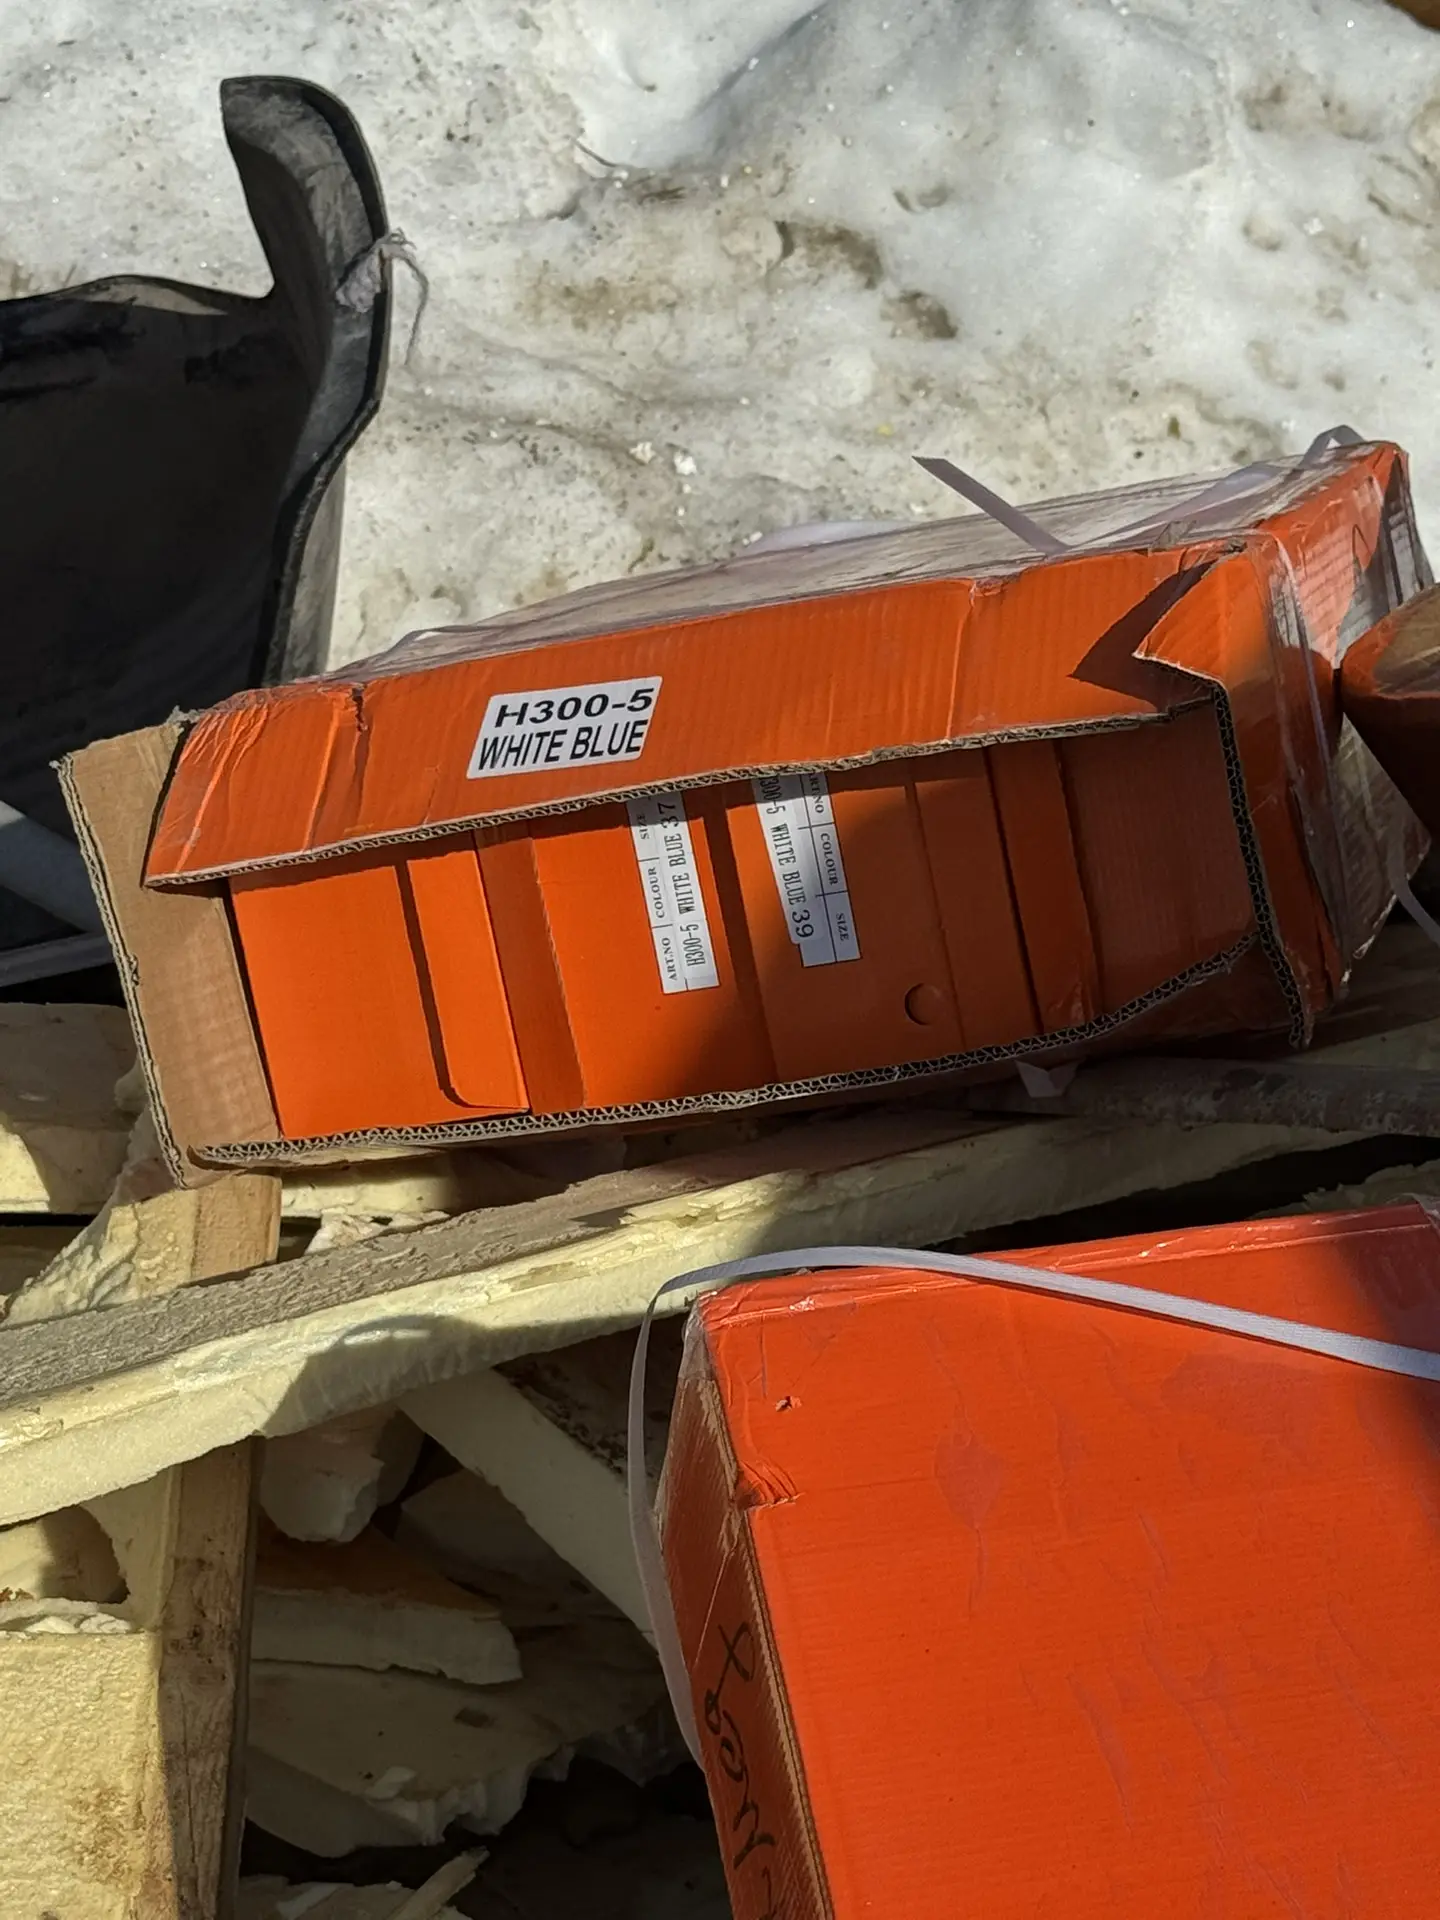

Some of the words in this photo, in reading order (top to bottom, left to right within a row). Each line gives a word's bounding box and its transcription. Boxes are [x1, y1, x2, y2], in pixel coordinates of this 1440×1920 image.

[494, 687, 654, 728] H300-5
[478, 729, 568, 770] WHITE
[569, 720, 648, 760] BLUE
[636, 814, 650, 839] SIZE
[658, 803, 678, 828] 37
[664, 833, 686, 867] BLUE
[770, 823, 796, 866] WHITE
[821, 833, 838, 886] COLOUR
[648, 867, 665, 918] COLOUR
[672, 872, 696, 914] WHITE
[783, 871, 807, 906] BLUE
[791, 909, 814, 938] 39
[835, 912, 850, 941] SIZE
[680, 923, 706, 966] H300-5
